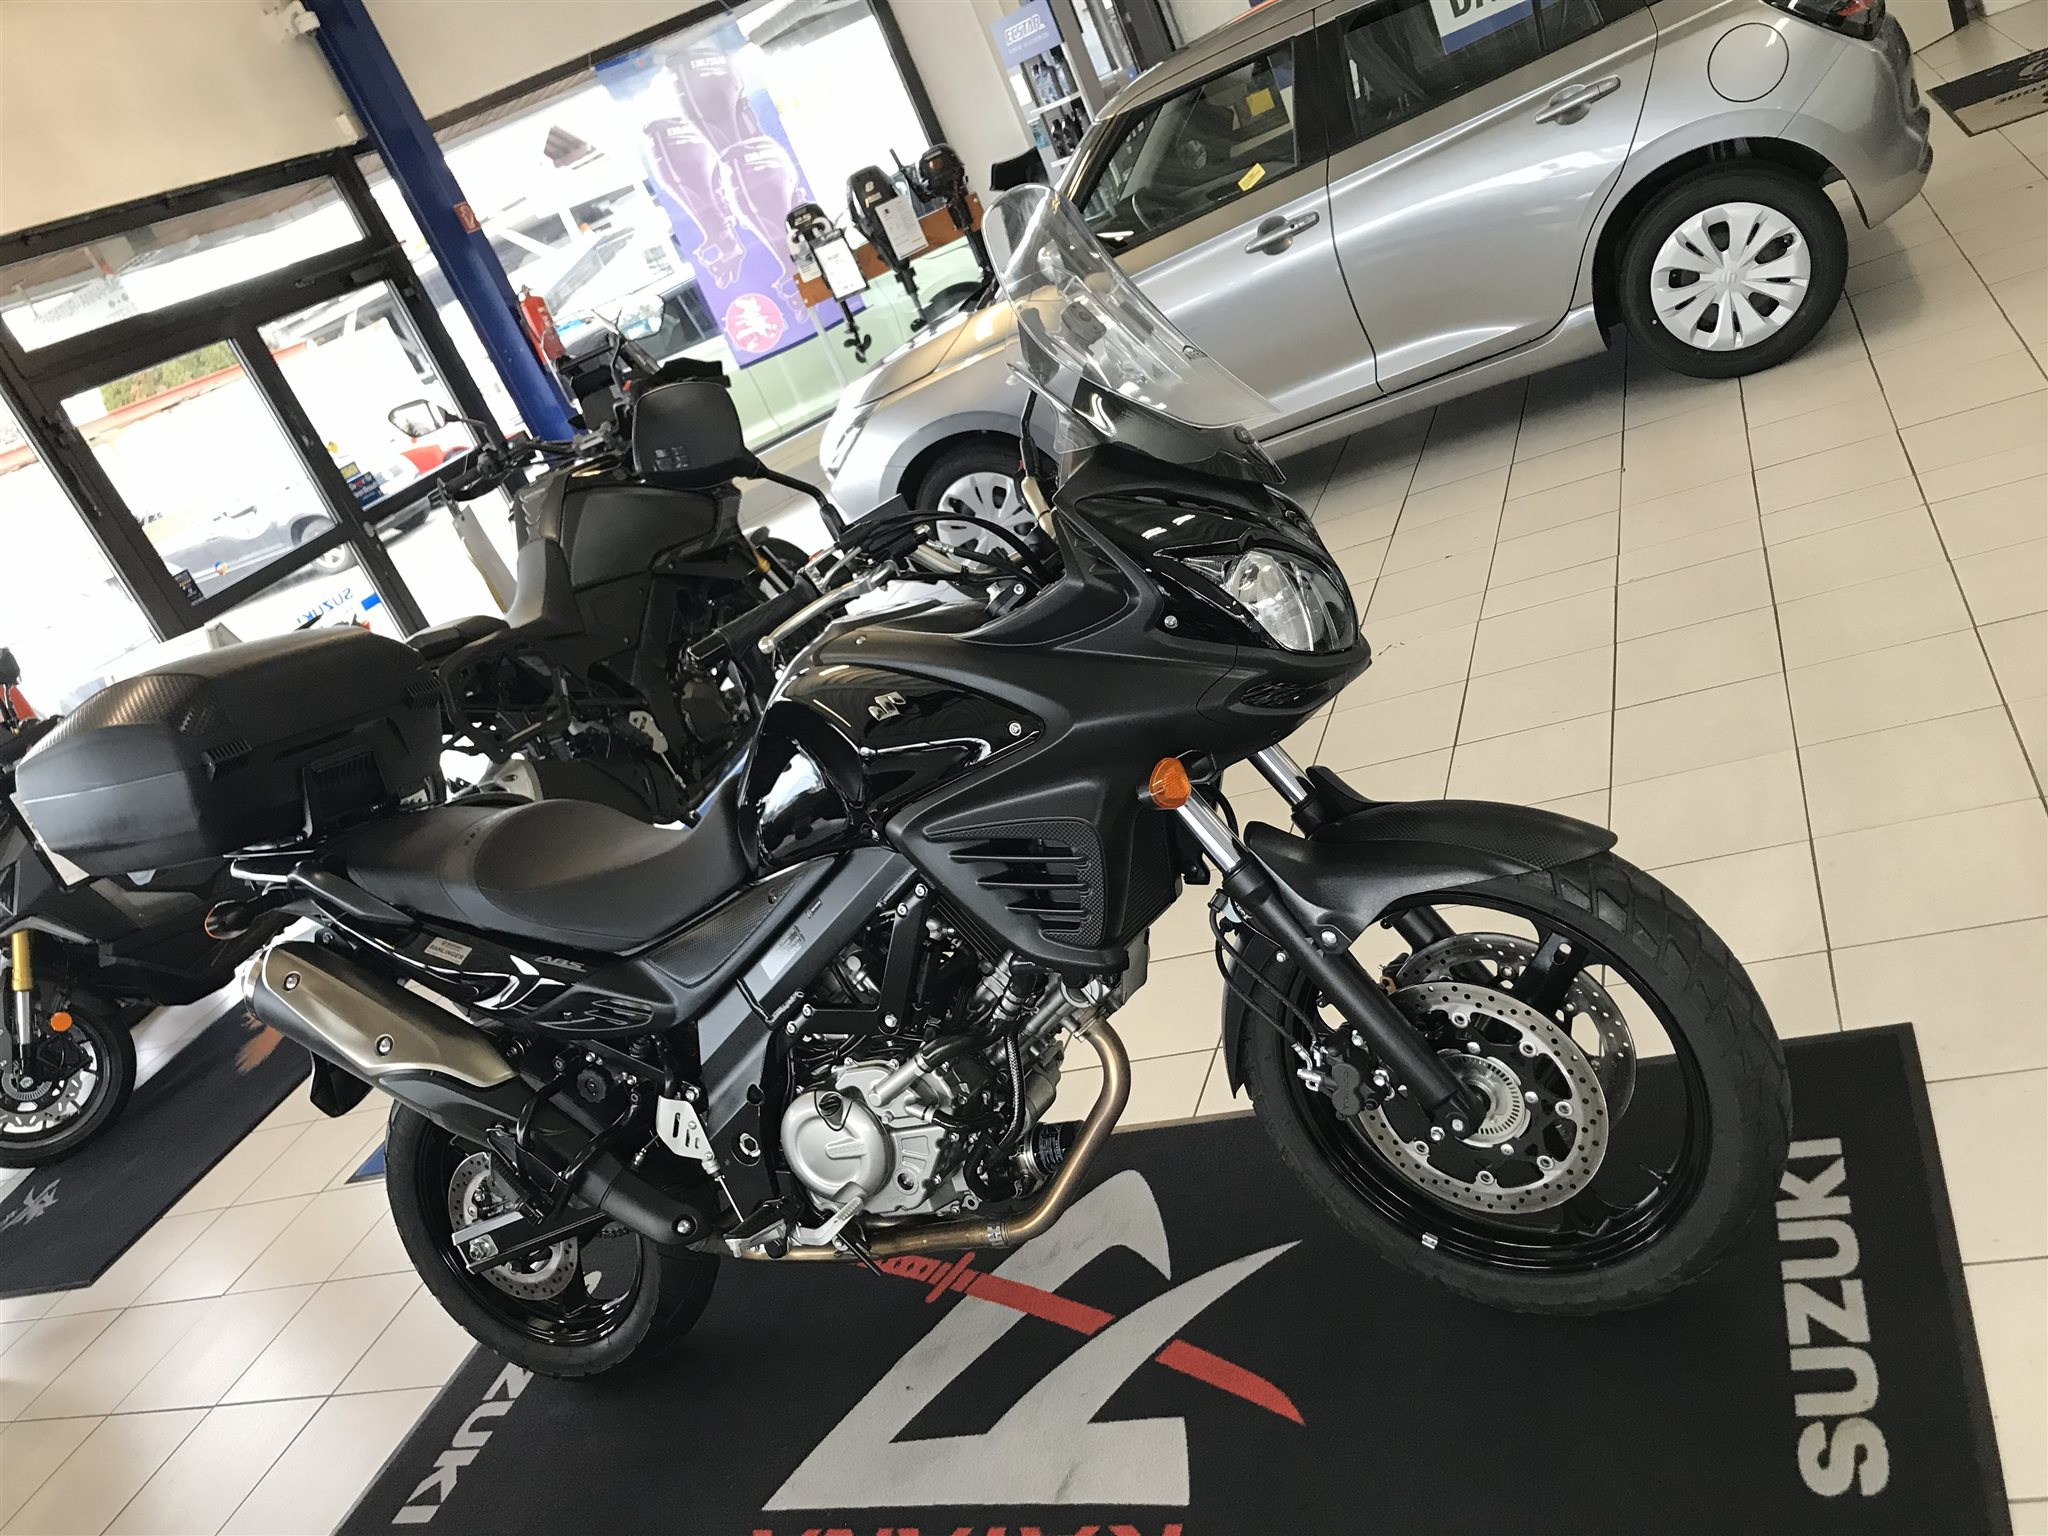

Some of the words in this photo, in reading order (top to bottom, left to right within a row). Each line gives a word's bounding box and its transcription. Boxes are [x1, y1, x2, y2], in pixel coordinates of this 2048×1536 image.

[1004, 13, 1046, 47] ECSTAR
[534, 955, 587, 973] ABS
[1775, 1137, 1890, 1497] SUZUKI
